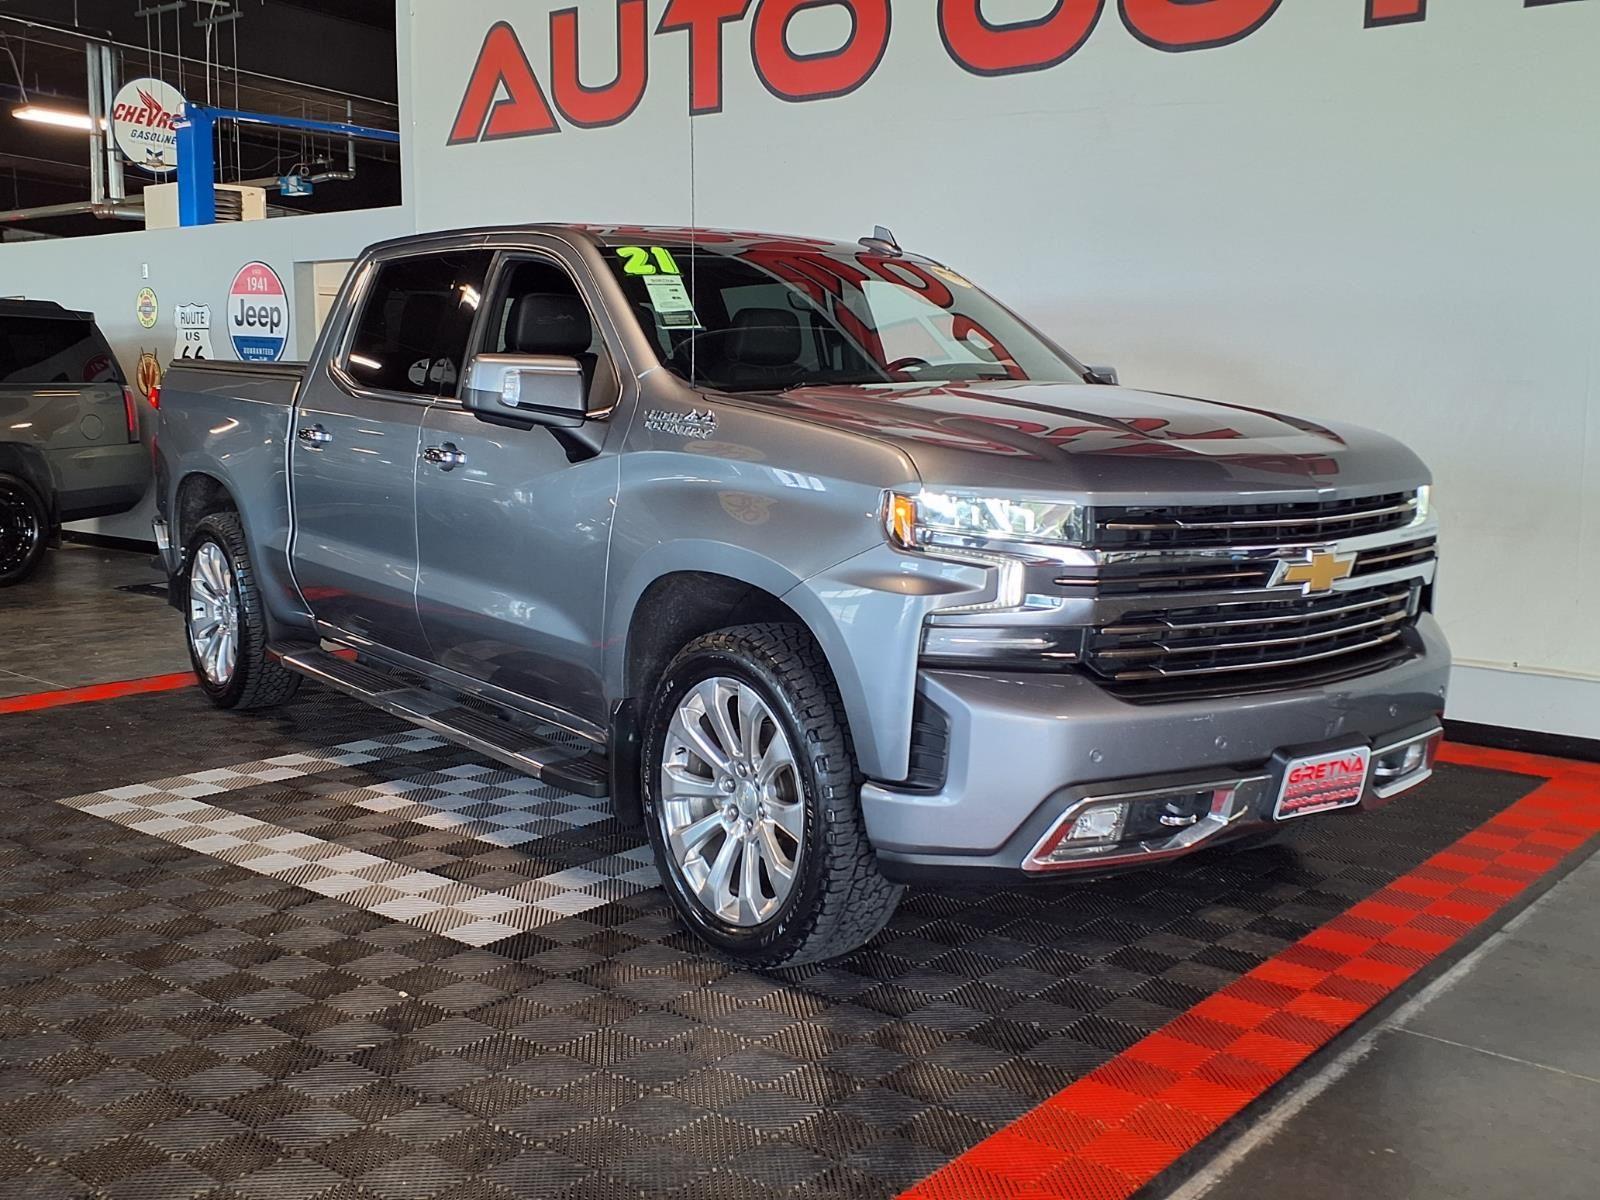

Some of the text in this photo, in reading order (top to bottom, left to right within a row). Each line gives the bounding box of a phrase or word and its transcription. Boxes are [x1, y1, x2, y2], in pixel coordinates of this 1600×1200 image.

[446, 0, 893, 146] AUTO
[130, 129, 177, 145] GASOLINE
[616, 246, 680, 275] 21
[246, 277, 268, 292] 1941
[180, 311, 205, 325] ROUTE
[234, 298, 281, 334] Jeep
[185, 331, 201, 341] US
[1288, 756, 1364, 784] GRETNA
